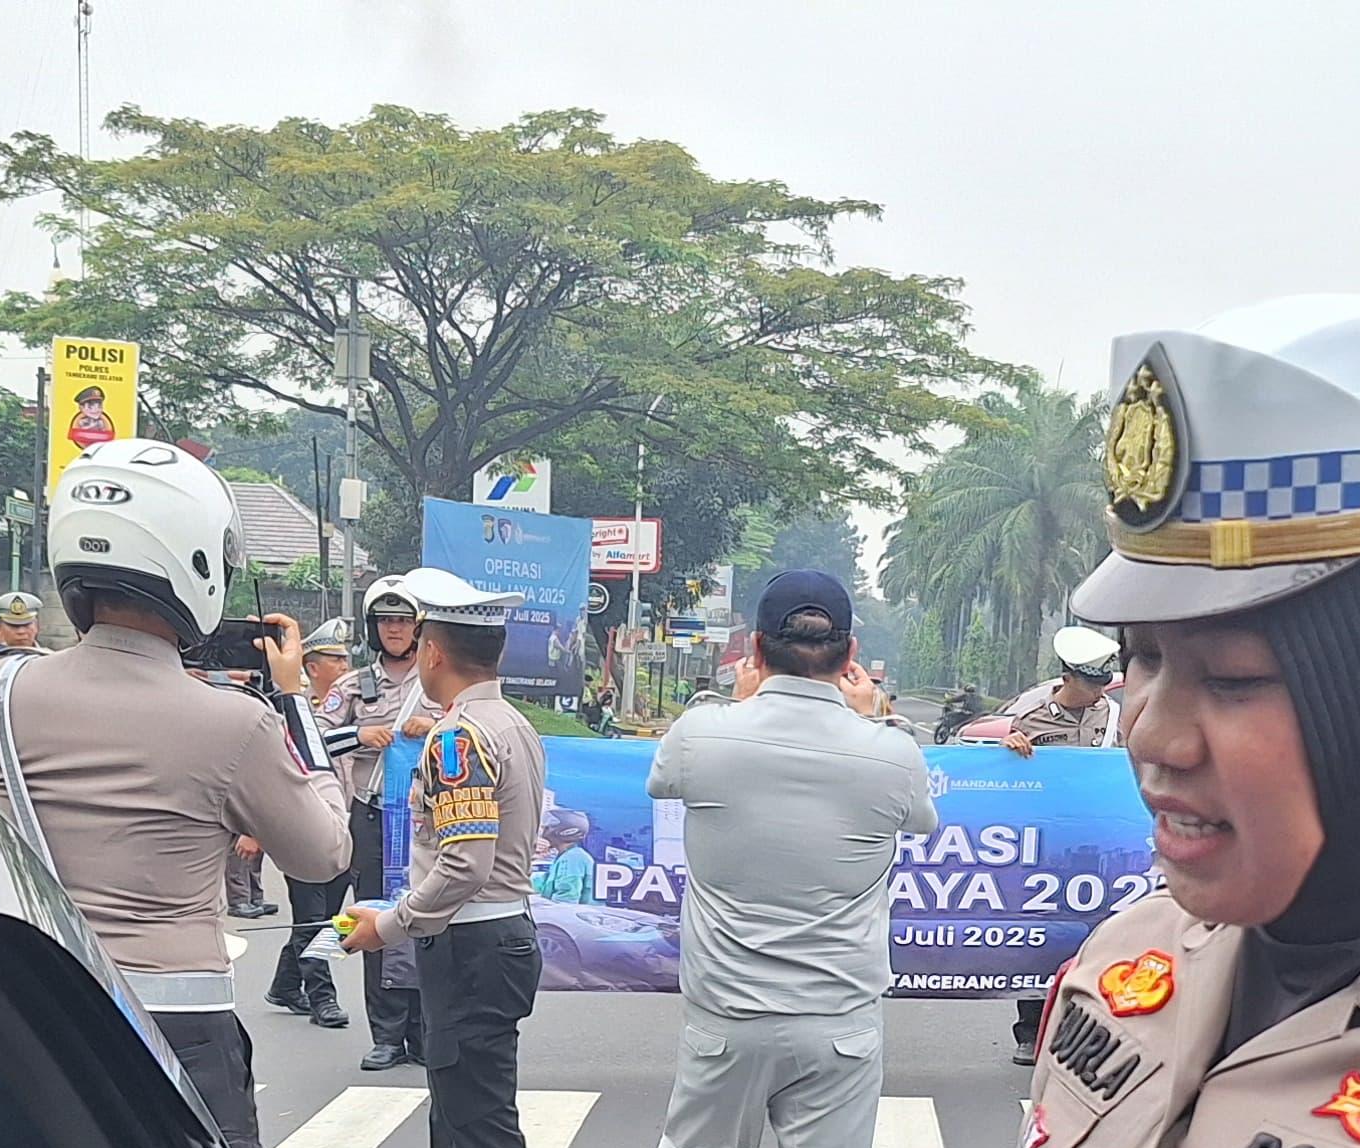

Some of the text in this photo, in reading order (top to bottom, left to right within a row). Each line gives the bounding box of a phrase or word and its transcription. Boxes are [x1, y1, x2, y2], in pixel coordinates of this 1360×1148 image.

[65, 344, 124, 364] POLISI
[82, 540, 110, 553] DOT
[484, 558, 542, 580] OPERASI
[538, 587, 566, 605] 2025
[530, 611, 551, 623] 2025
[950, 780, 1044, 790] MANDALA JAYA
[893, 925, 1047, 947] Juli 2025
[890, 973, 1007, 990] TANGERANG
